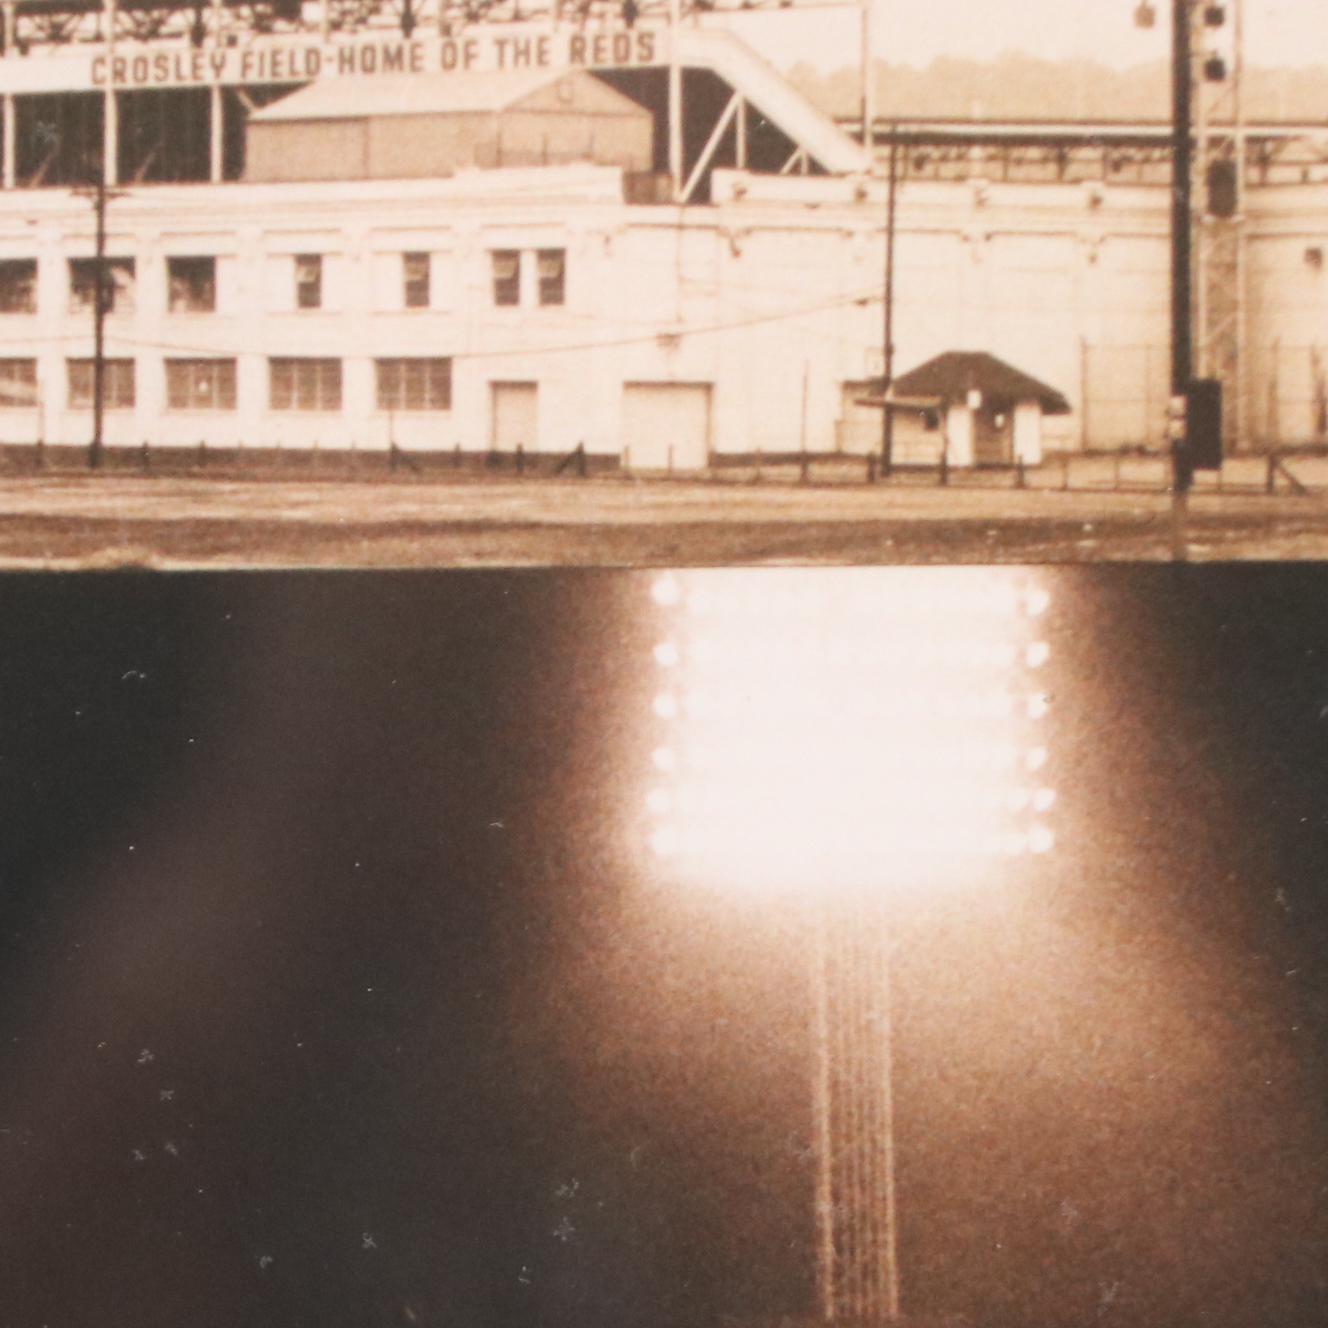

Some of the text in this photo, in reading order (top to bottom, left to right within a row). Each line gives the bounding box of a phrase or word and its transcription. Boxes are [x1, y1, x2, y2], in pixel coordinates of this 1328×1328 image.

[91, 49, 228, 86] CROSLEY
[440, 38, 480, 69] OF
[494, 34, 552, 66] THE
[569, 30, 657, 63] REDS
